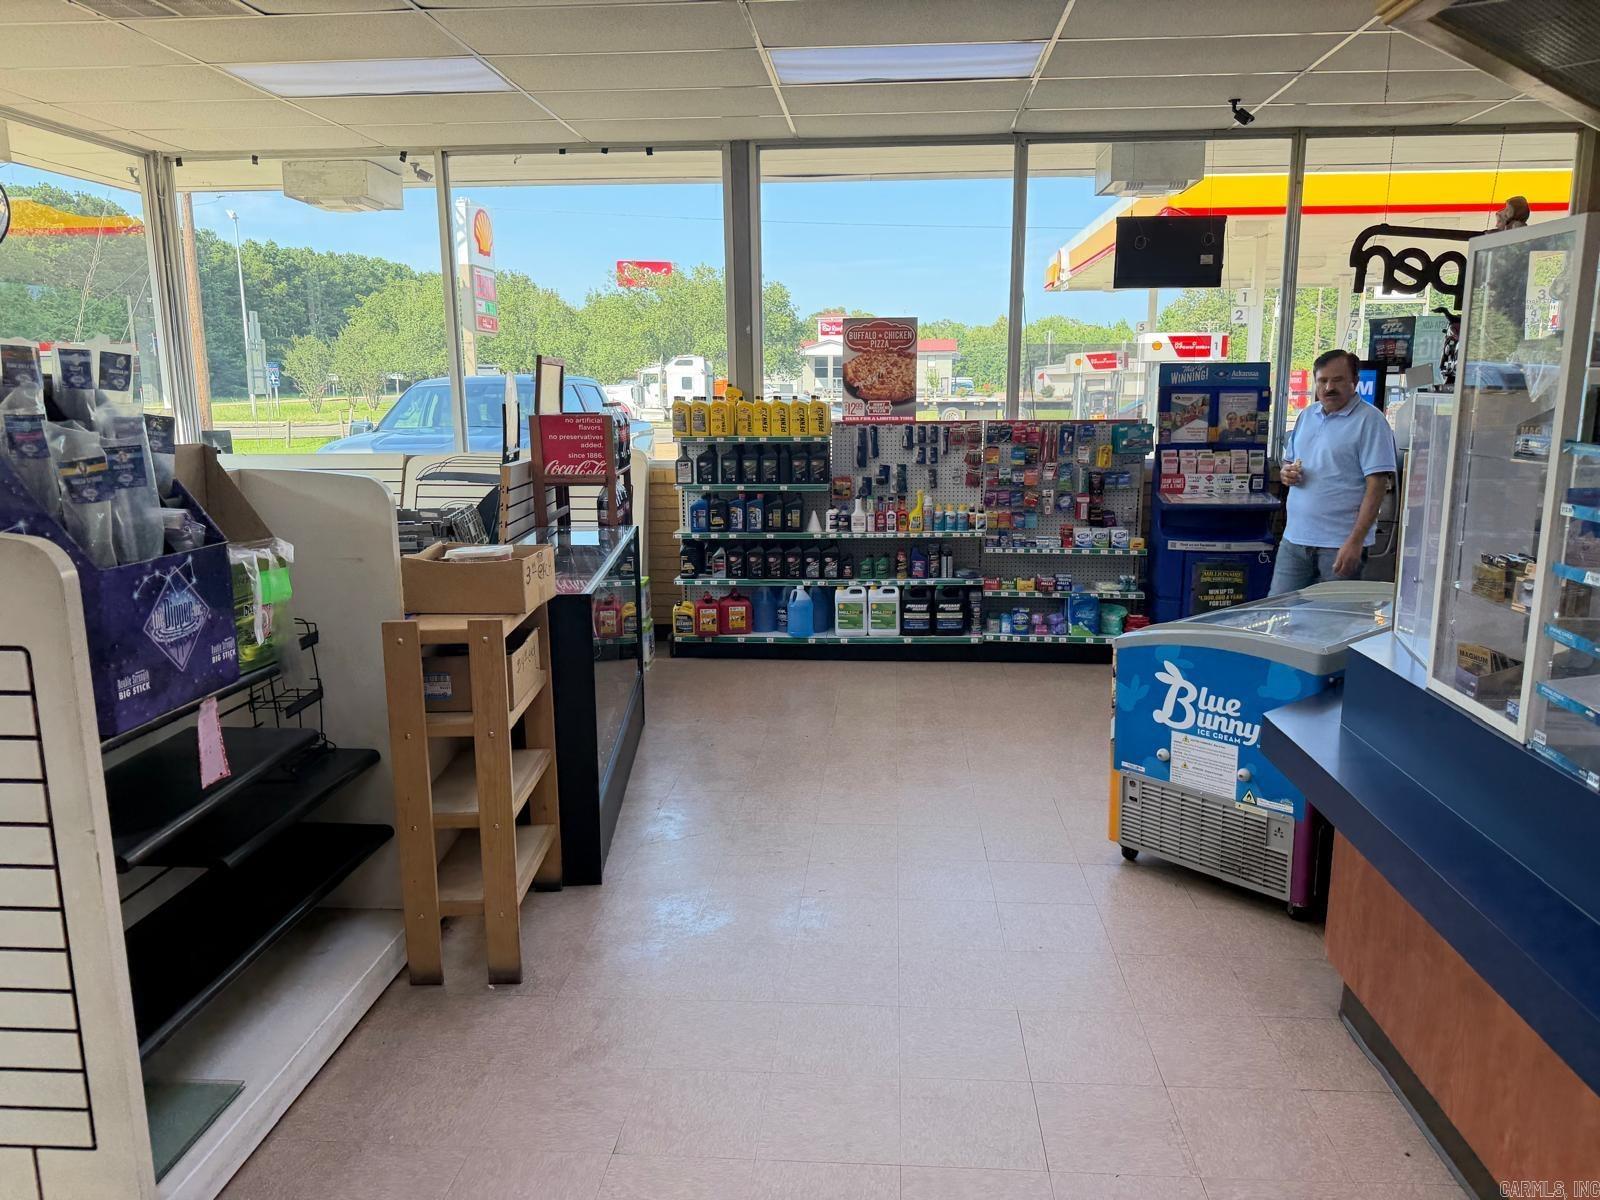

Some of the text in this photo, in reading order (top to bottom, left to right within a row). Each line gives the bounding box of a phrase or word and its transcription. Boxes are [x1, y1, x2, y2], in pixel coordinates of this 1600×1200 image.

[1242, 291, 1248, 303] 1
[1234, 309, 1244, 321] 2
[848, 330, 912, 340] BUFFALO CHICKEN
[1139, 323, 1145, 332] 5
[870, 340, 890, 348] PIZZA
[1171, 367, 1259, 384] WINNING! Arkansas
[559, 433, 604, 441] preservatives
[544, 459, 607, 476] Coca-Cola
[163, 598, 193, 630] Dipper
[211, 648, 236, 664] BIG STICK
[1459, 650, 1489, 665] MAGNUM
[118, 681, 151, 700] BIG STICK
[1197, 728, 1241, 744] ICE CREAM
